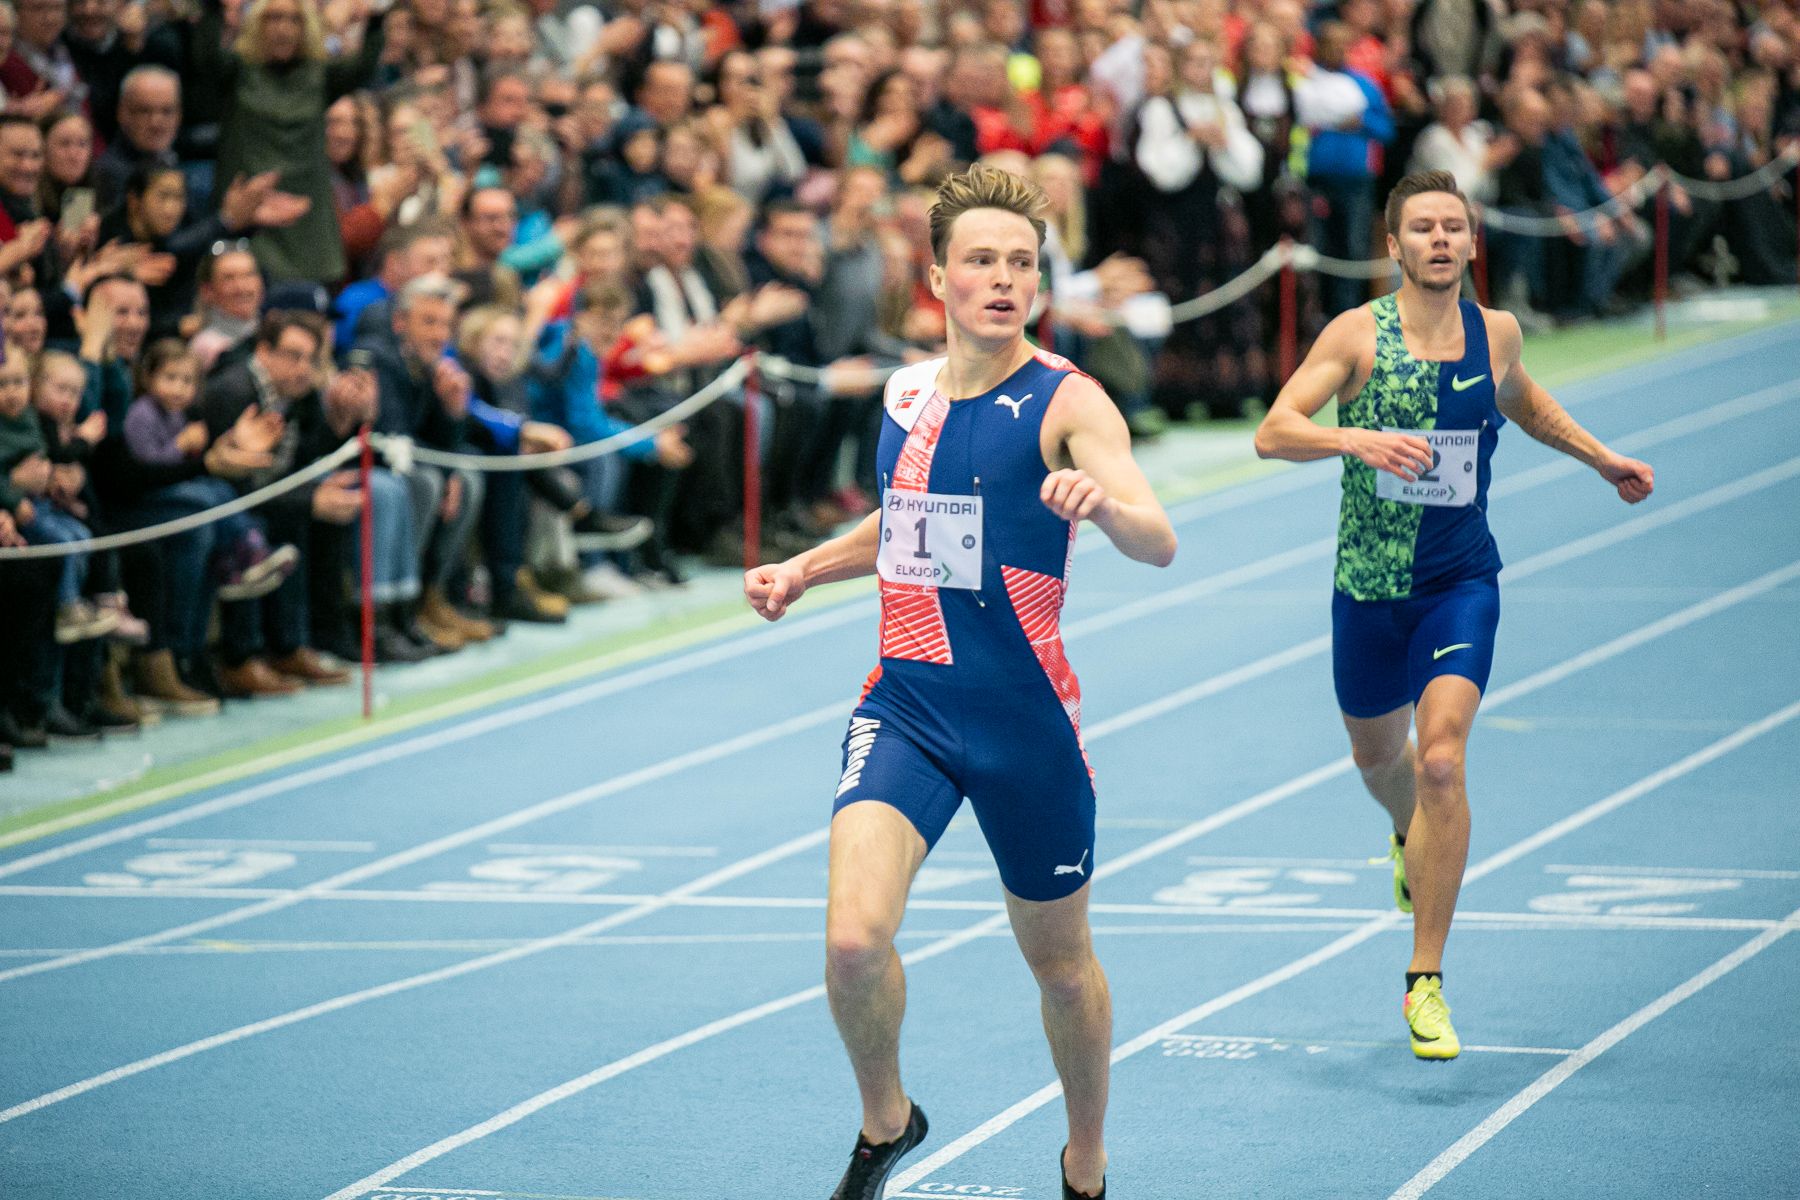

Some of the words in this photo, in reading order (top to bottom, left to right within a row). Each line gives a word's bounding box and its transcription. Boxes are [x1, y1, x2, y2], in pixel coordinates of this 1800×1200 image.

[1426, 435, 1475, 447] YUNDAI
[1417, 449, 1441, 482] 2
[907, 499, 977, 515] HYUNDAI
[913, 516, 932, 559] 1
[83, 850, 297, 887] 6
[420, 854, 642, 893] 5
[1152, 867, 1357, 906] 3
[1527, 874, 1744, 915] 2
[917, 1182, 1028, 1197] 200
